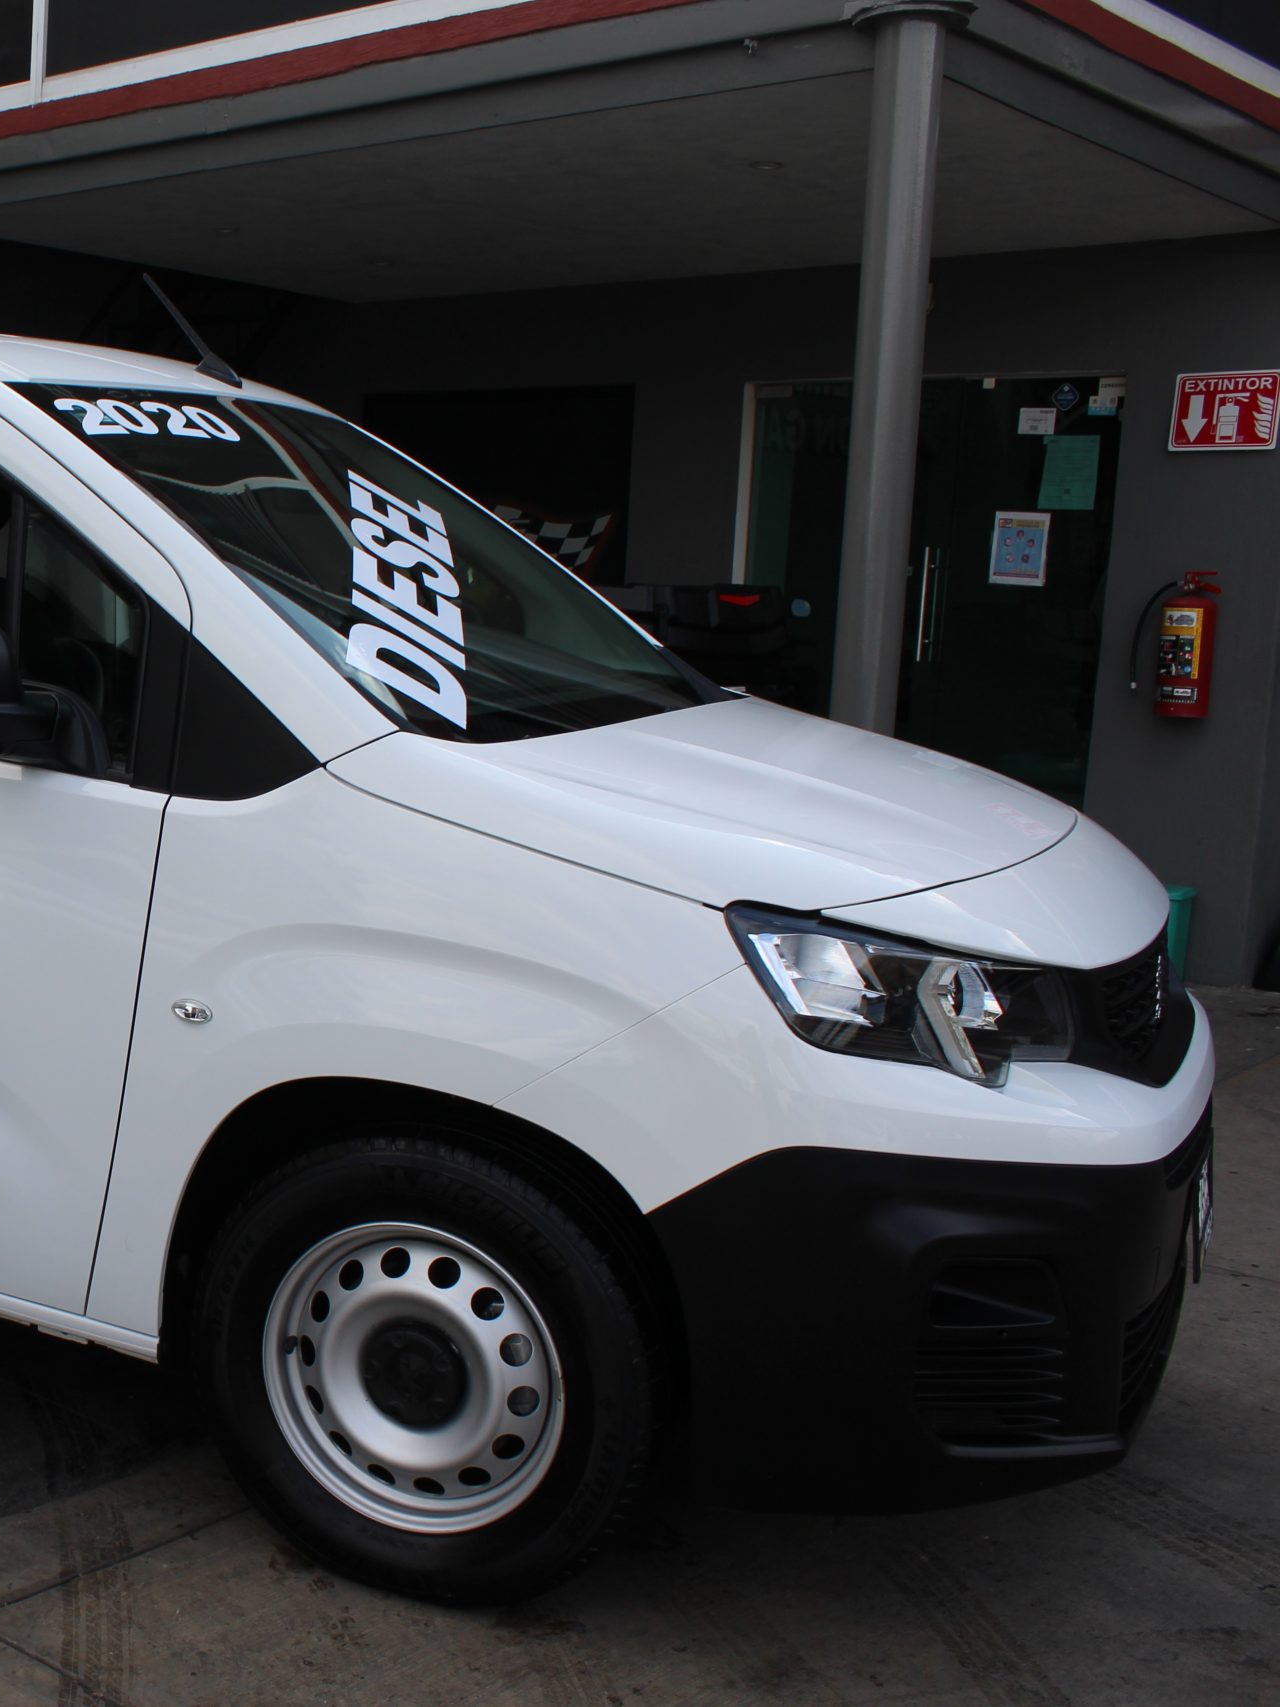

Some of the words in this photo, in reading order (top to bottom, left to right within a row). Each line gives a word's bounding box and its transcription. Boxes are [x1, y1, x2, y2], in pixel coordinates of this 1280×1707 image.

[1184, 377, 1273, 393] EXTINTOR
[53, 398, 241, 443] 2020
[345, 469, 468, 731] DIESEL
